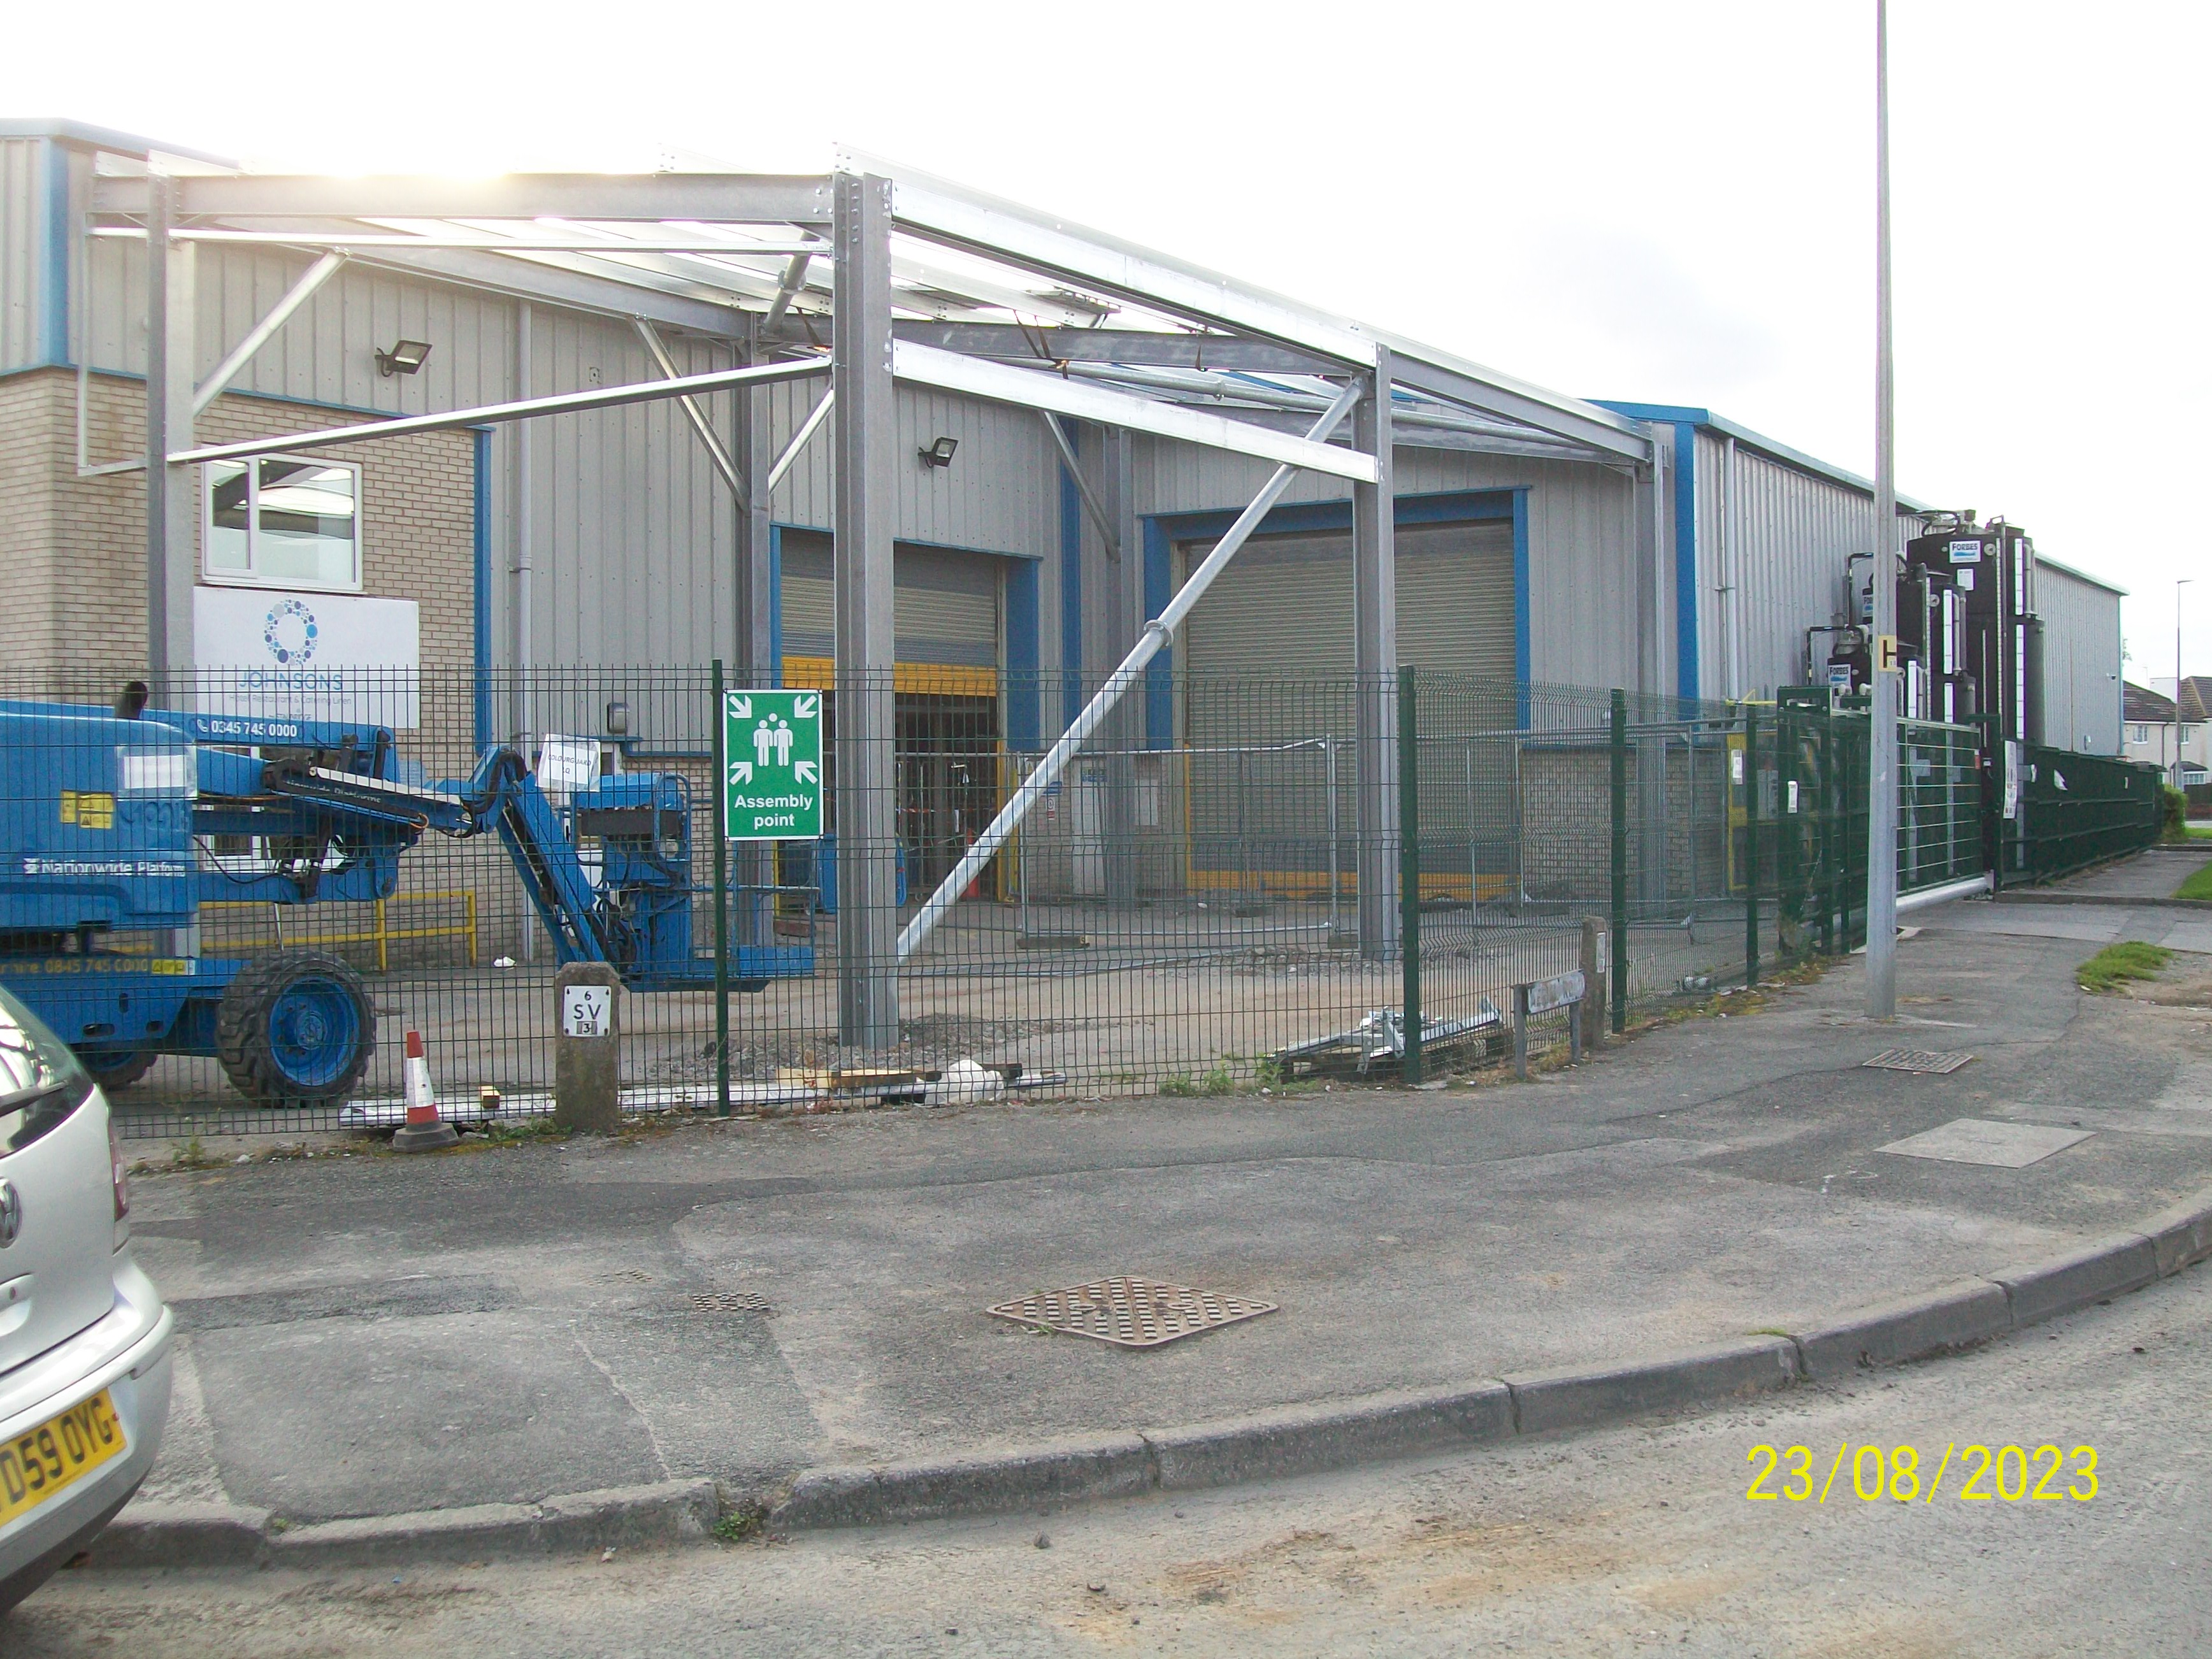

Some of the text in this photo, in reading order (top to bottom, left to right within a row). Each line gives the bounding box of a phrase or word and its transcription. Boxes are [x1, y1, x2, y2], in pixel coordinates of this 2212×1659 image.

[1952, 543, 1978, 551] FORBES
[239, 672, 343, 690] JOHNSONS
[211, 720, 298, 738] 0345 745 0000
[734, 793, 813, 811] Assembly
[754, 813, 795, 830] point
[42, 858, 133, 877] Nationwide
[584, 990, 592, 1001] 6
[583, 1023, 591, 1033] 3
[0, 1397, 114, 1511] D59 OYG
